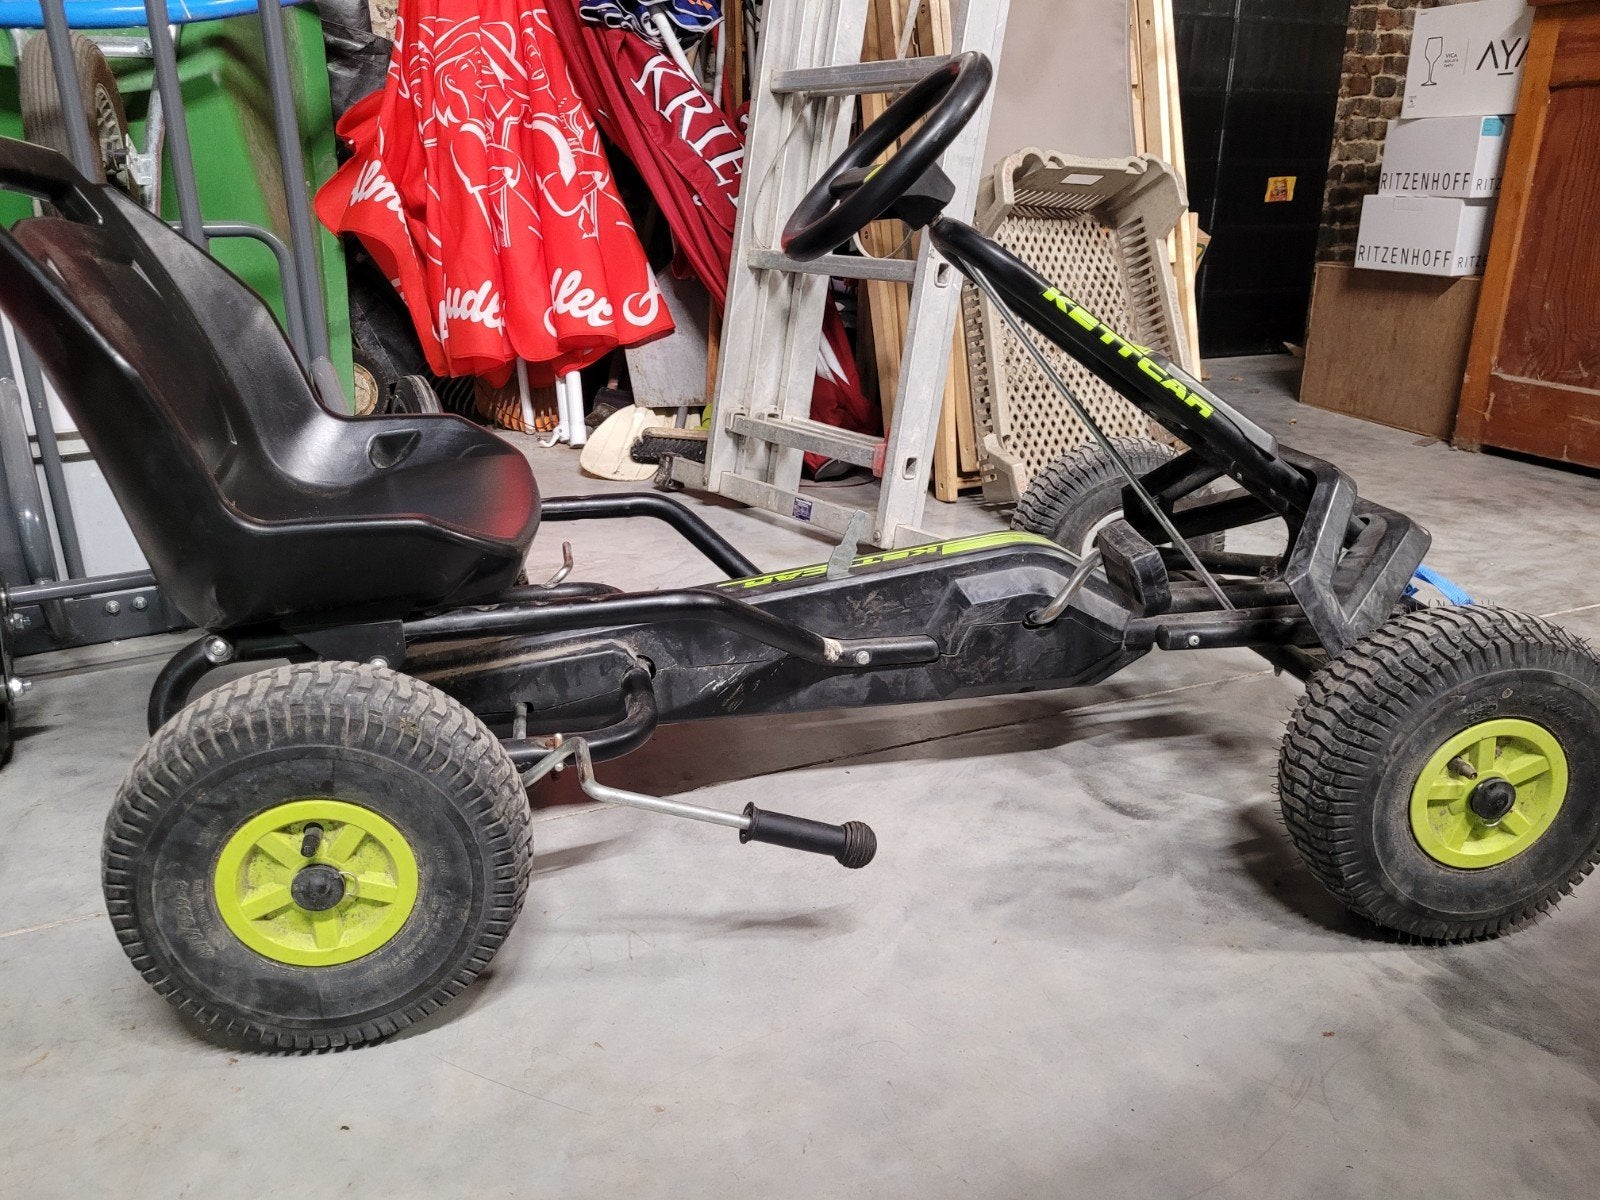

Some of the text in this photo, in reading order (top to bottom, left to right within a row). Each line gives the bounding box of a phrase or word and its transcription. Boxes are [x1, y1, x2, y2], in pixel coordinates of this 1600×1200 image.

[630, 51, 745, 209] KRIE
[1379, 172, 1471, 191] RITZENHOFF
[1357, 244, 1452, 268] RITZENHOFF
[1043, 286, 1215, 419] KETTCAR
